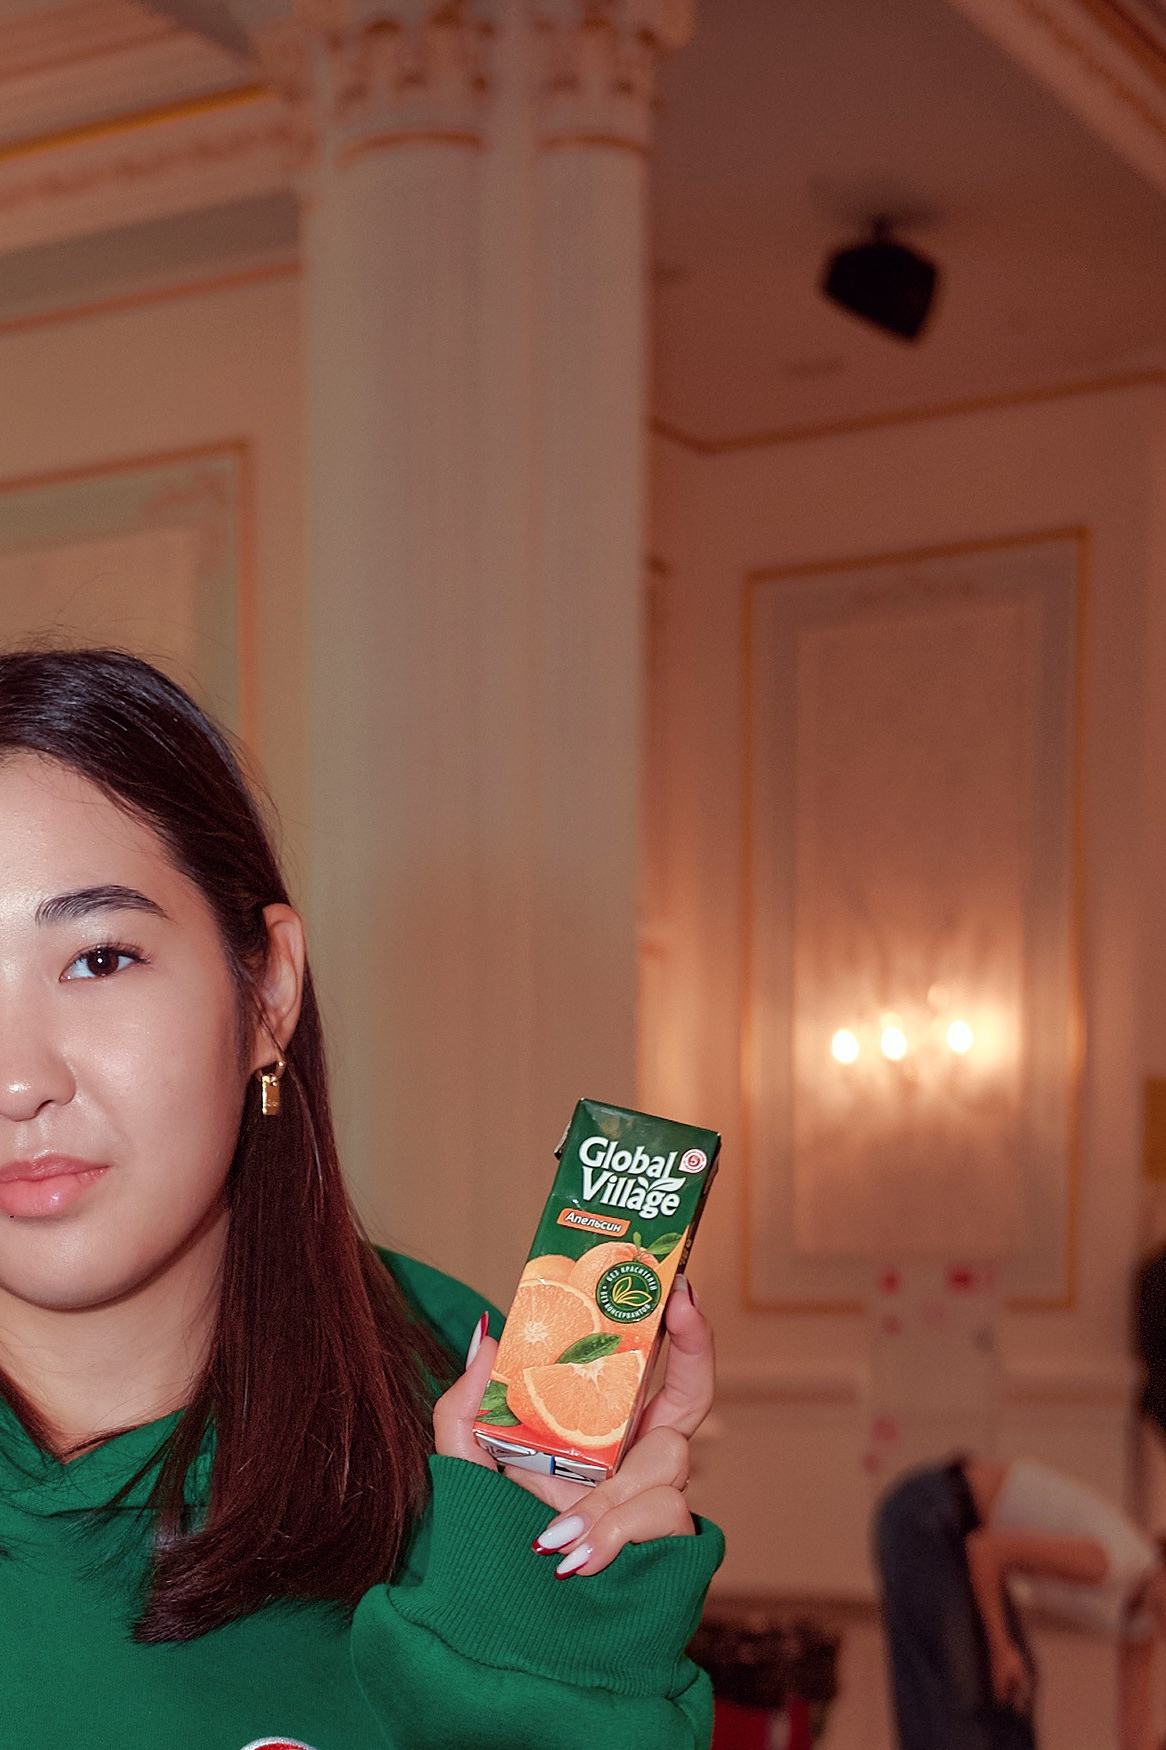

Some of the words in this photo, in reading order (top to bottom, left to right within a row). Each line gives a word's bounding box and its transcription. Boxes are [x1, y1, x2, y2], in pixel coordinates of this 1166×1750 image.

[578, 1136, 679, 1179] Global
[582, 1166, 681, 1219] Village
[565, 1211, 622, 1232] Апельсин
